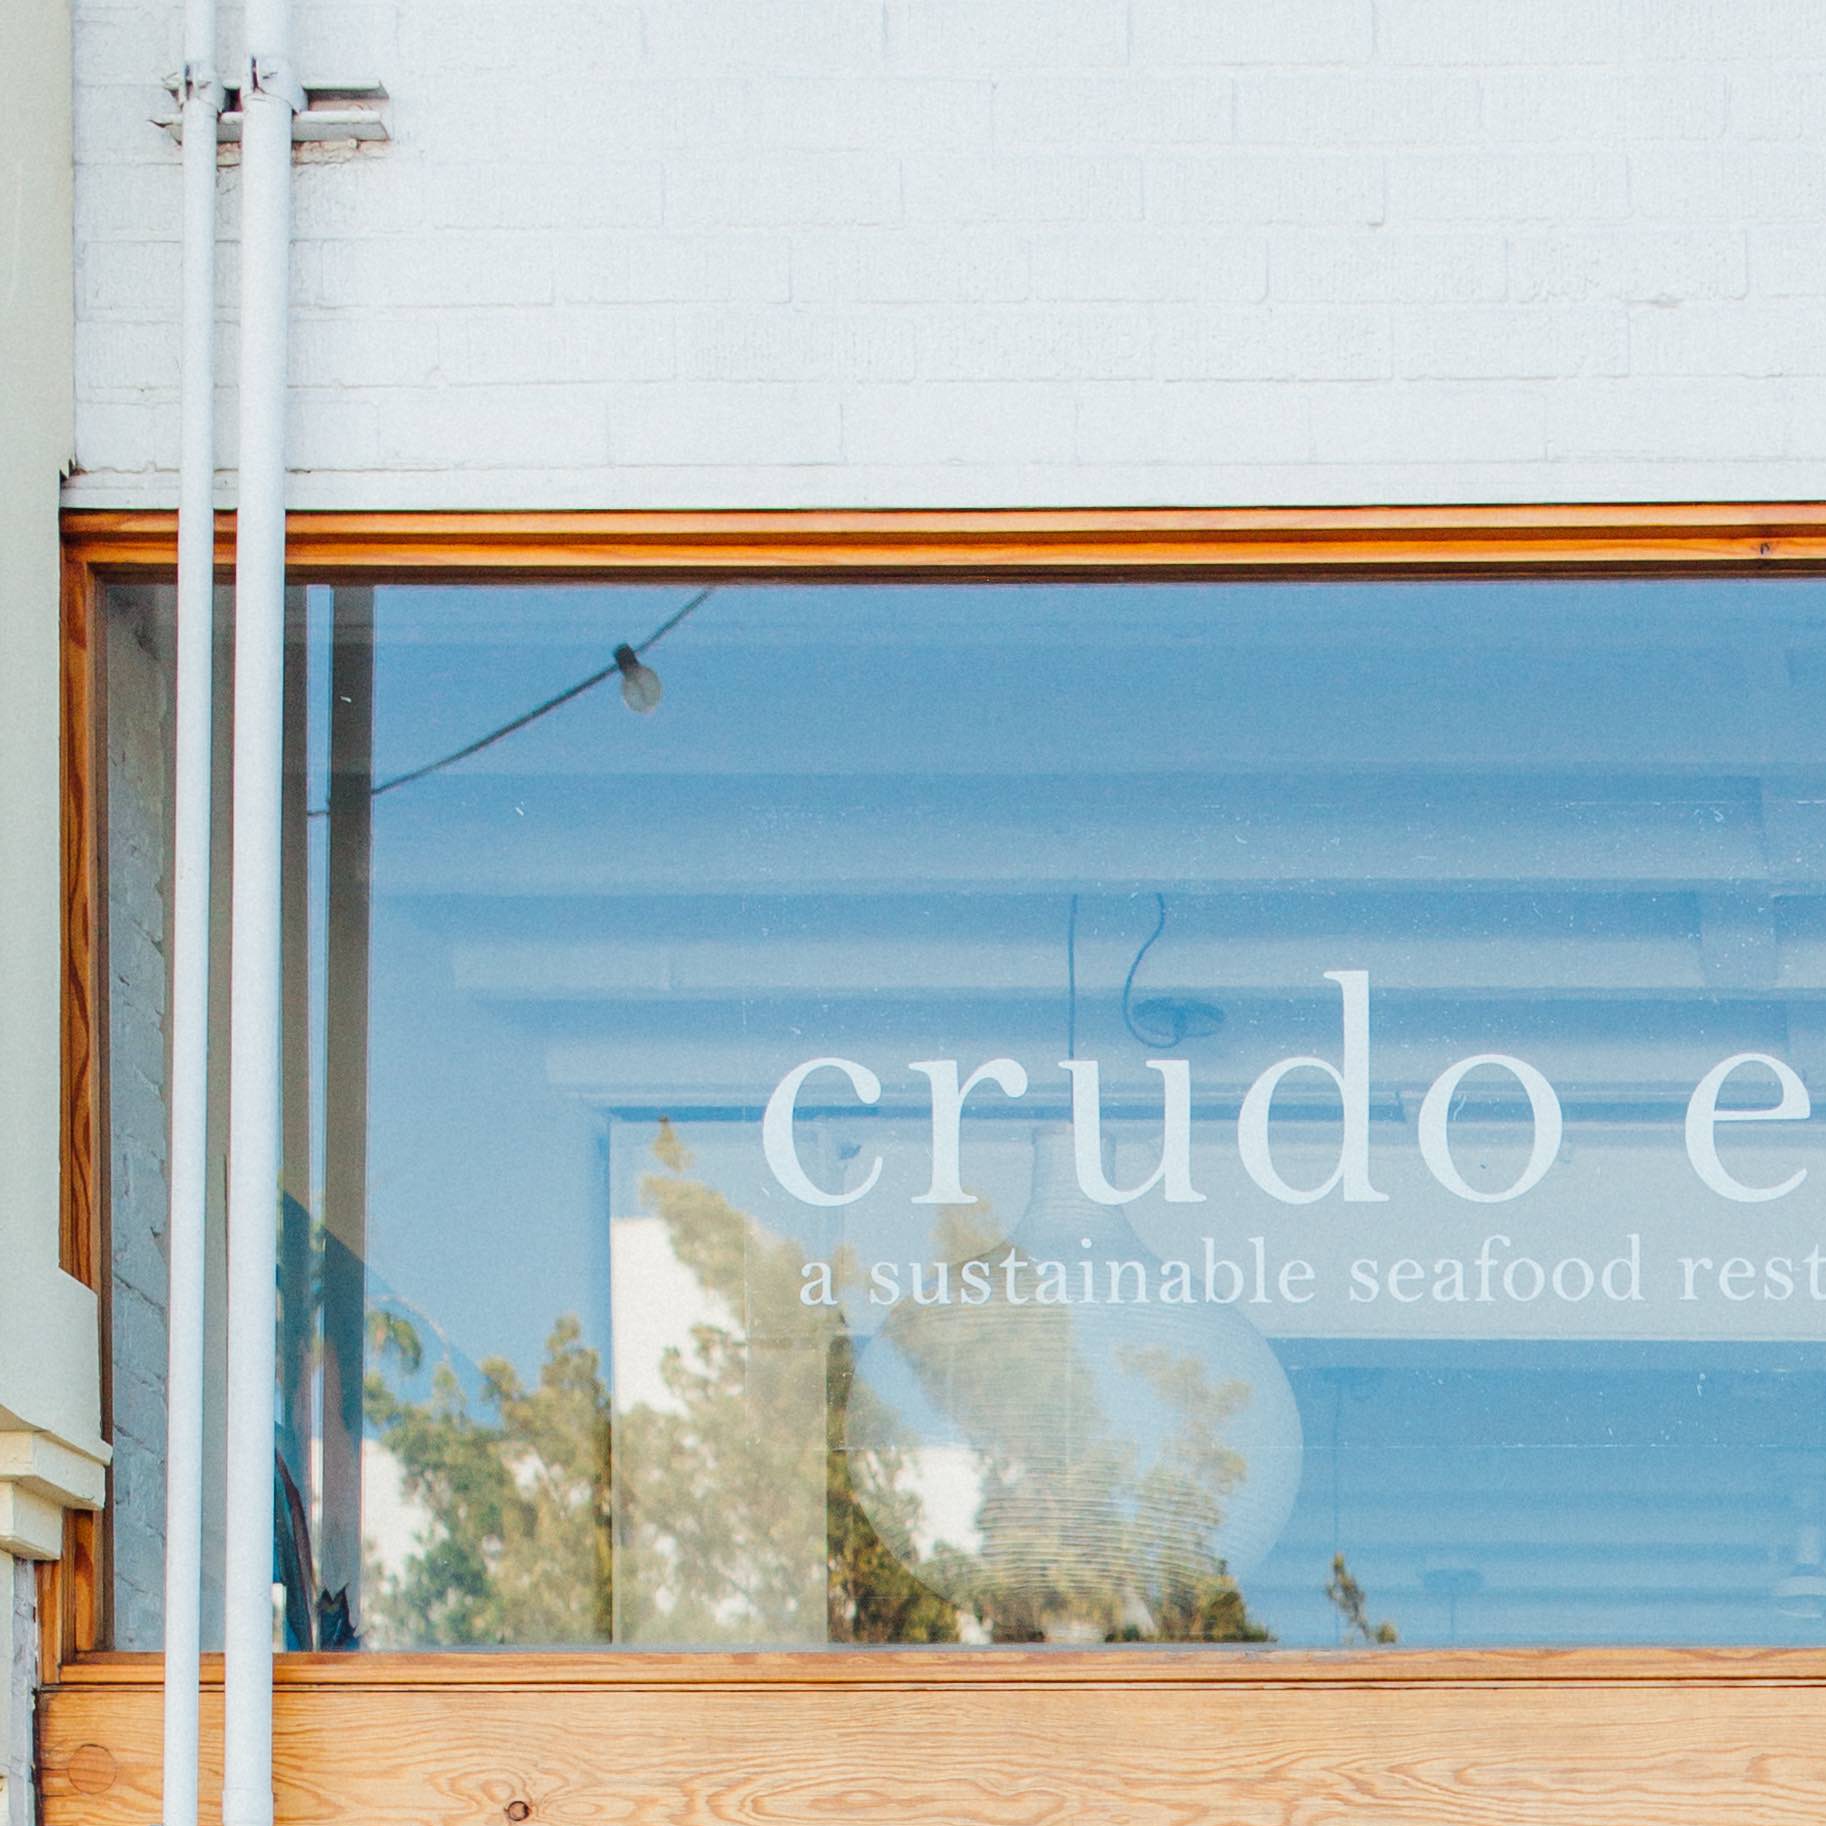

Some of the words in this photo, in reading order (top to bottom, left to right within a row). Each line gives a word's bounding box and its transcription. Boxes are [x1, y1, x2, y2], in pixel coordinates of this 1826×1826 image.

[762, 968, 1563, 1206] crudo
[1684, 1050, 1811, 1202] e
[799, 1262, 837, 1306] a
[870, 1236, 1316, 1305] sustainable
[1350, 1233, 1644, 1302] seafood
